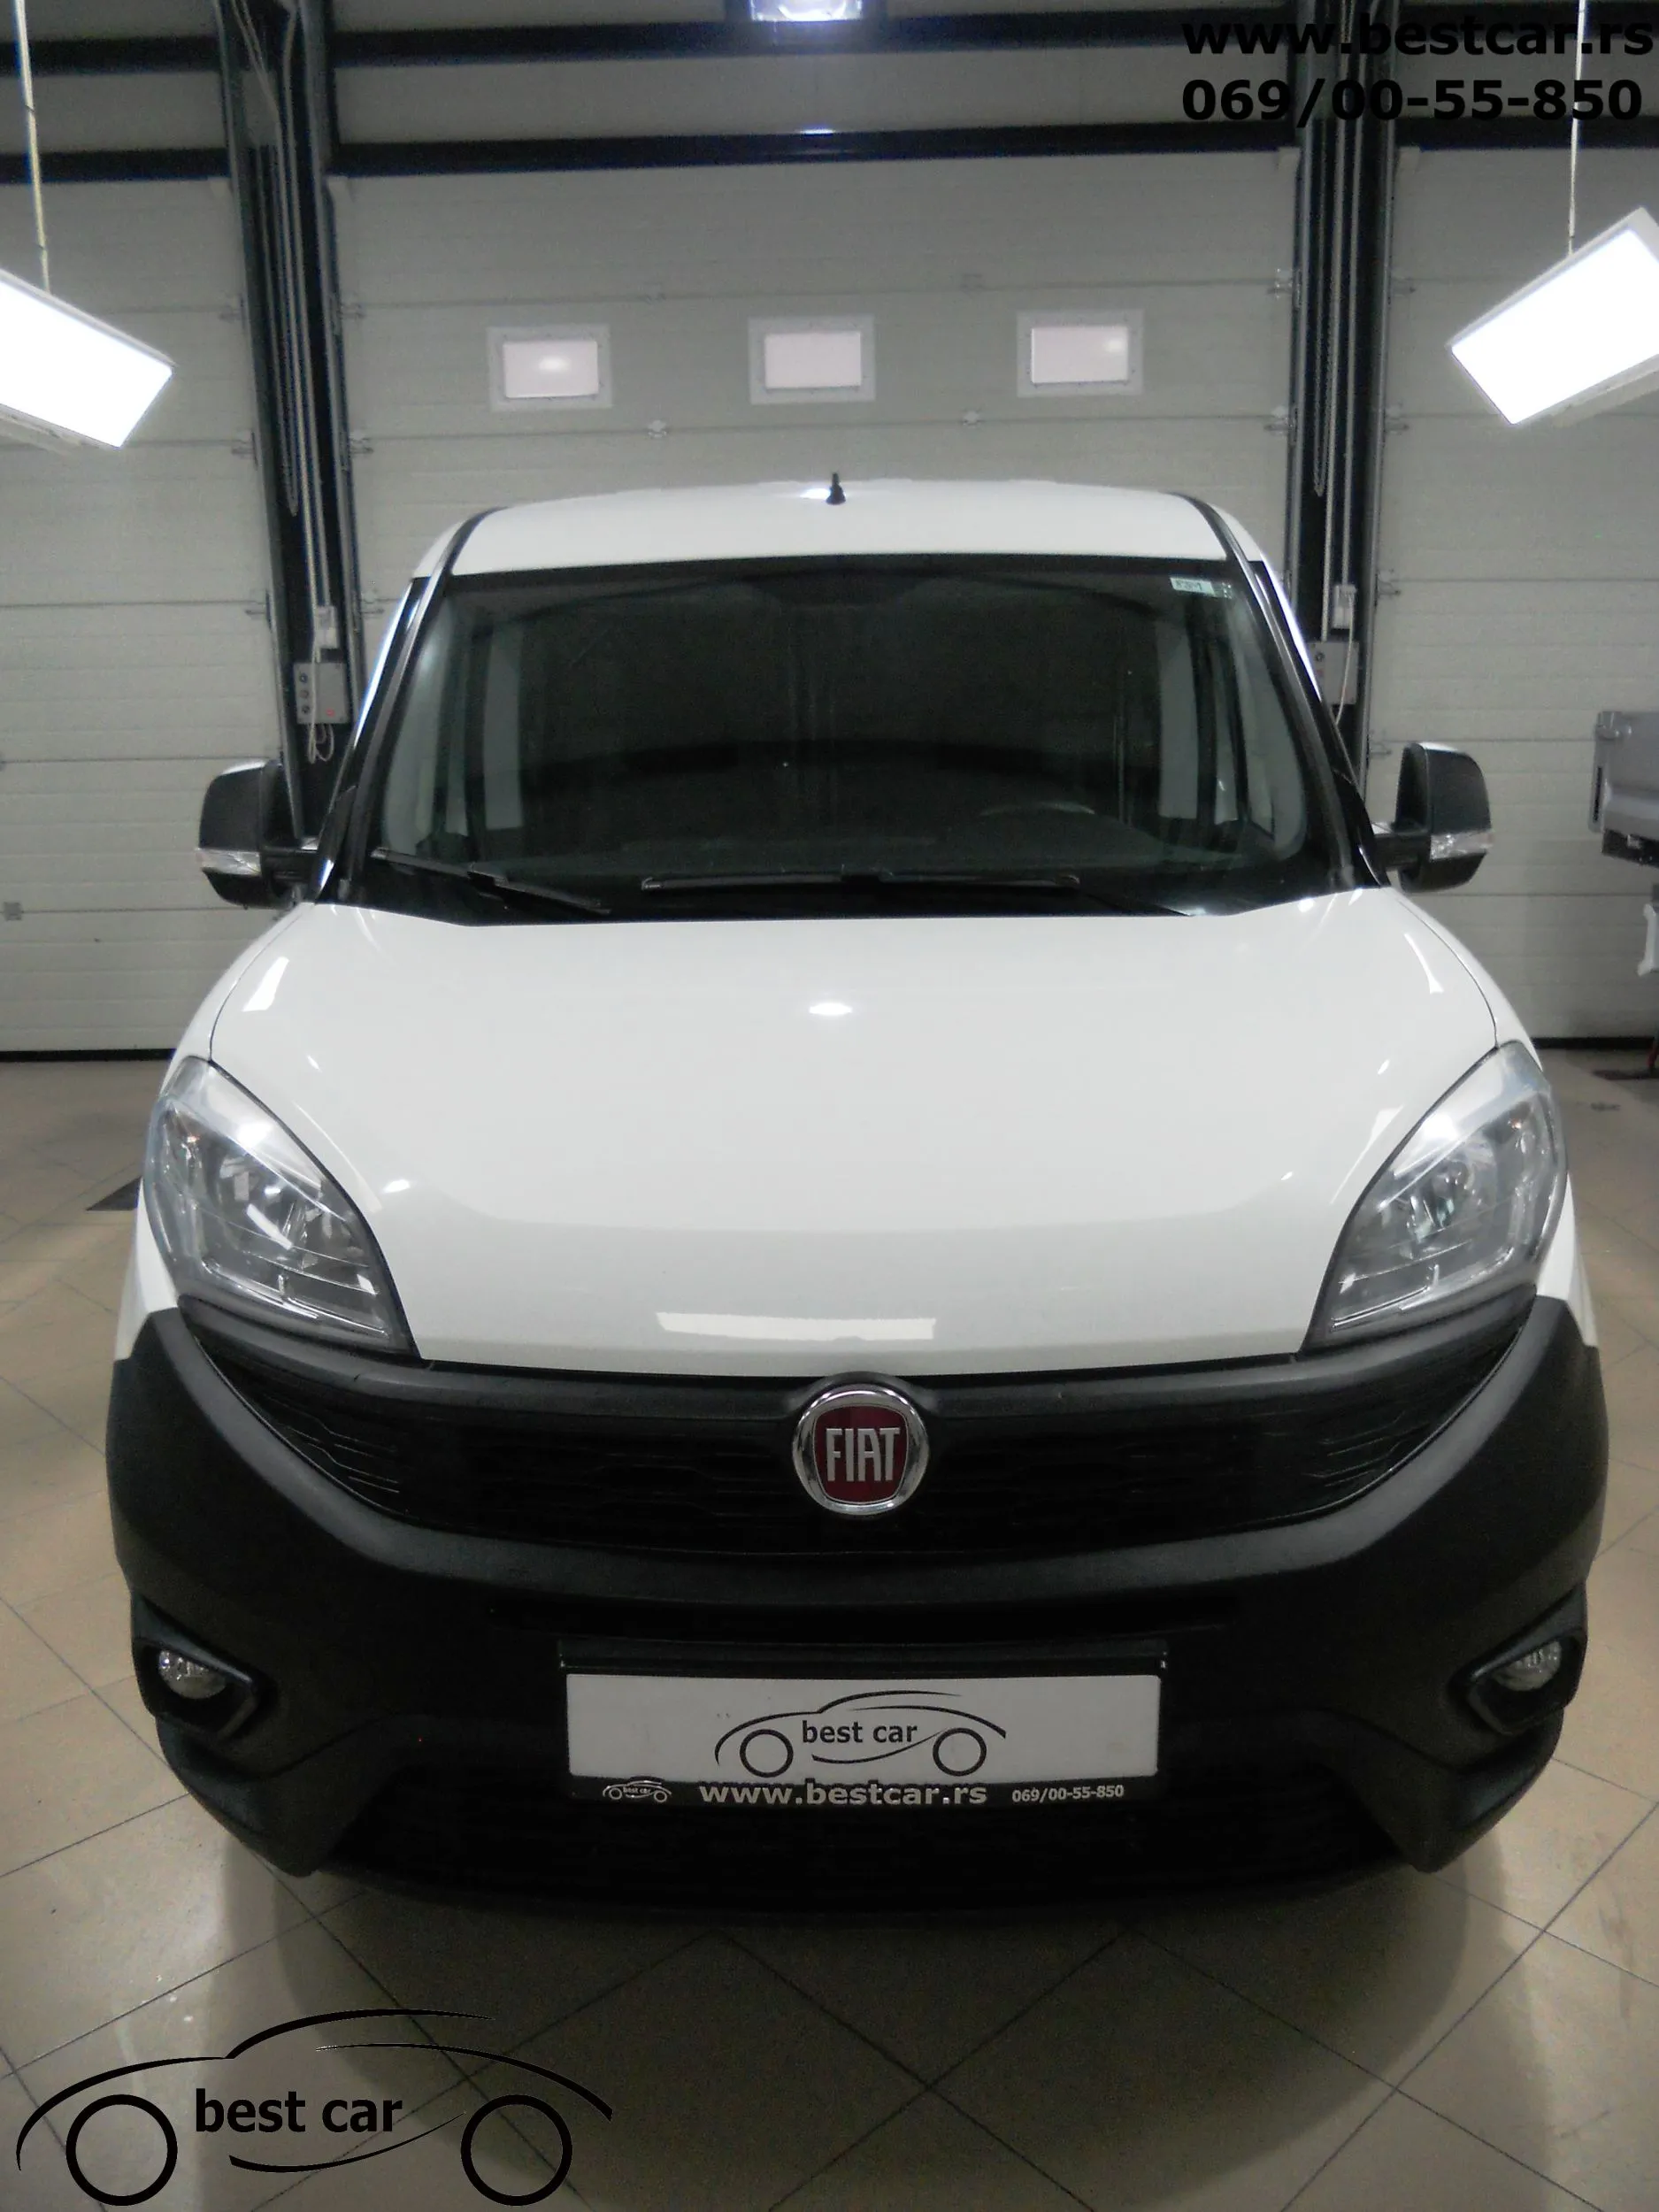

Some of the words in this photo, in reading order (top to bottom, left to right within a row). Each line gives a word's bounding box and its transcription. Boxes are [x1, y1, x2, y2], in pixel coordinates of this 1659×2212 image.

[826, 1427, 900, 1482] FIAT
[803, 1721, 864, 1743] best
[872, 1724, 918, 1744] car
[699, 1778, 987, 1806] www.bestcar.rs
[1012, 1785, 1125, 1802] 069/00-55-850
